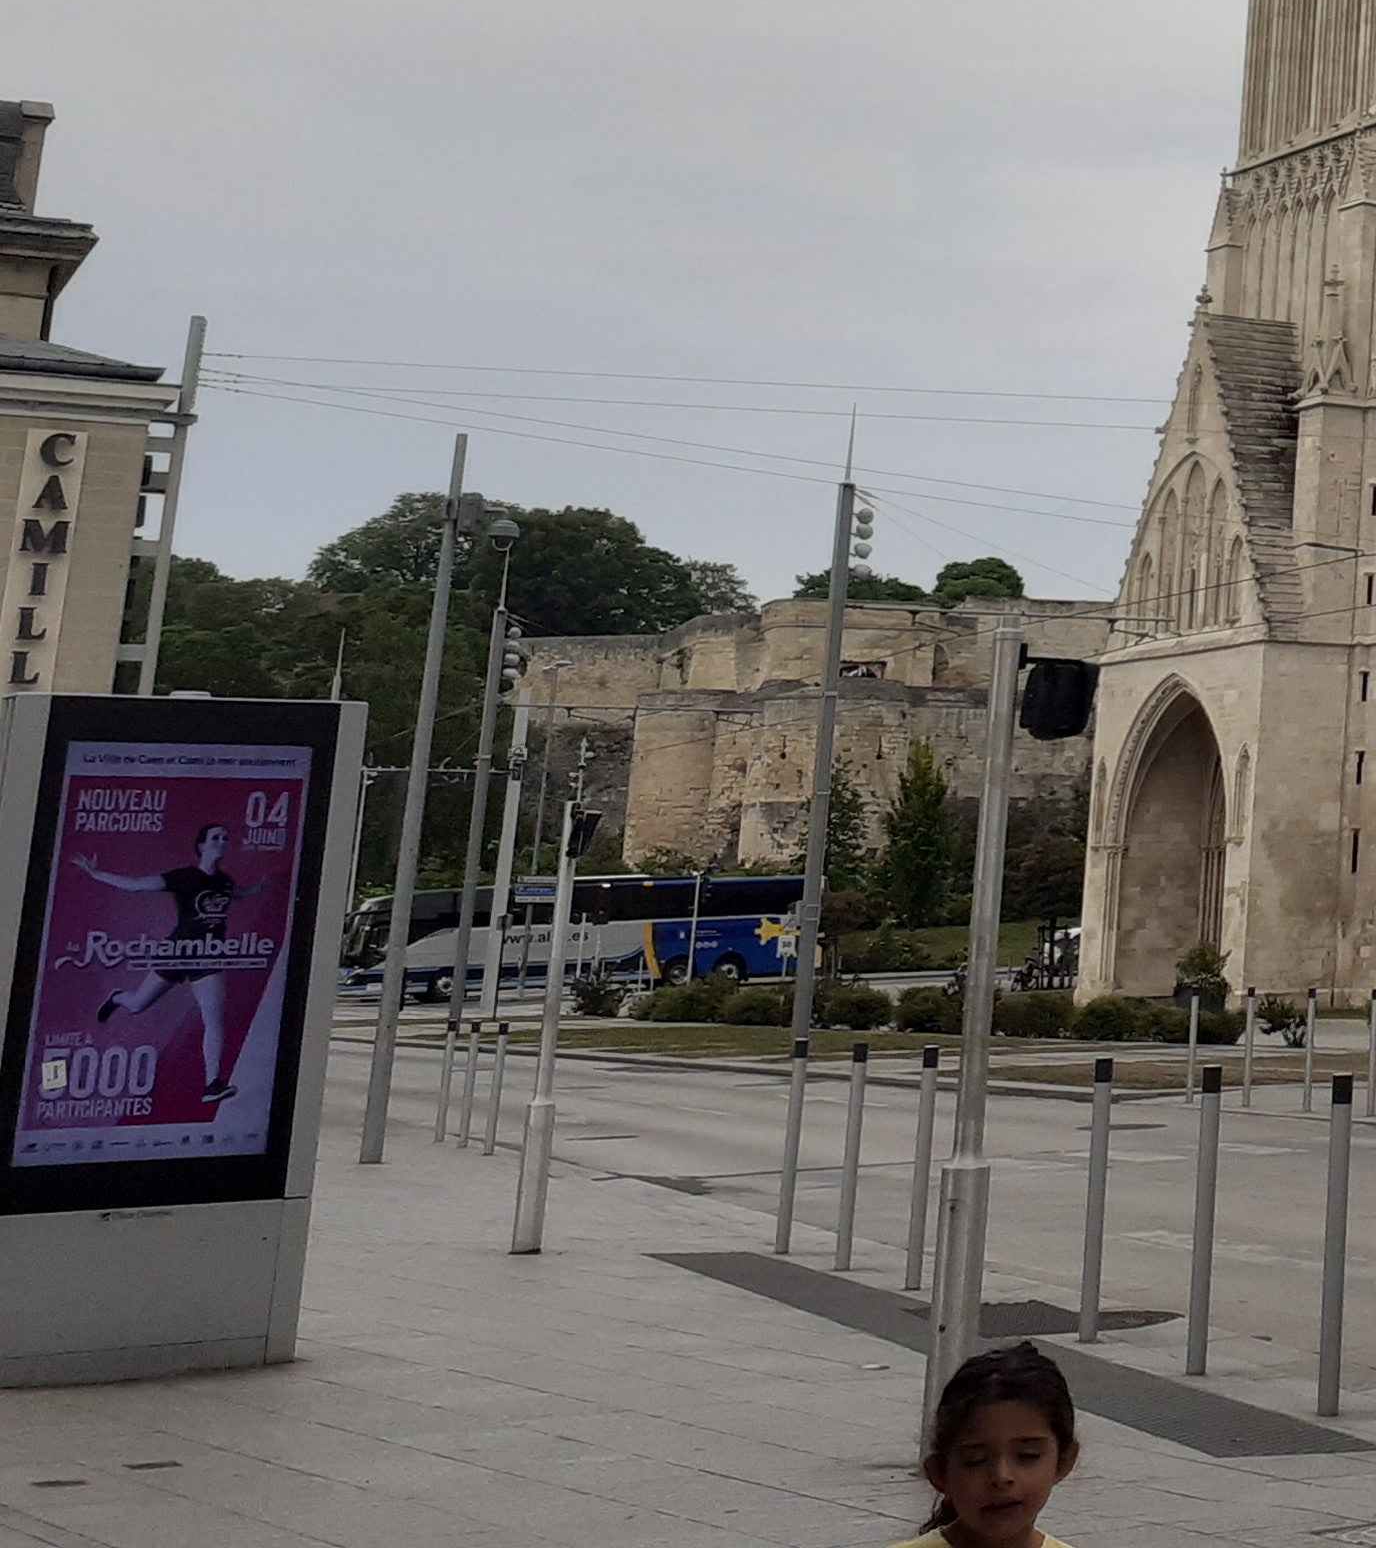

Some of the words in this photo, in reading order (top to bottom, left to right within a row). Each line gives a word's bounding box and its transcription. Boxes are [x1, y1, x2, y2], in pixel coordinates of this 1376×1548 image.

[76, 788, 167, 812] NOUVEAU
[245, 791, 289, 828] 04
[74, 812, 164, 832] PARCOURS
[72, 931, 275, 967] Rochambelle
[36, 1098, 153, 1119] PARTICIPANTES
